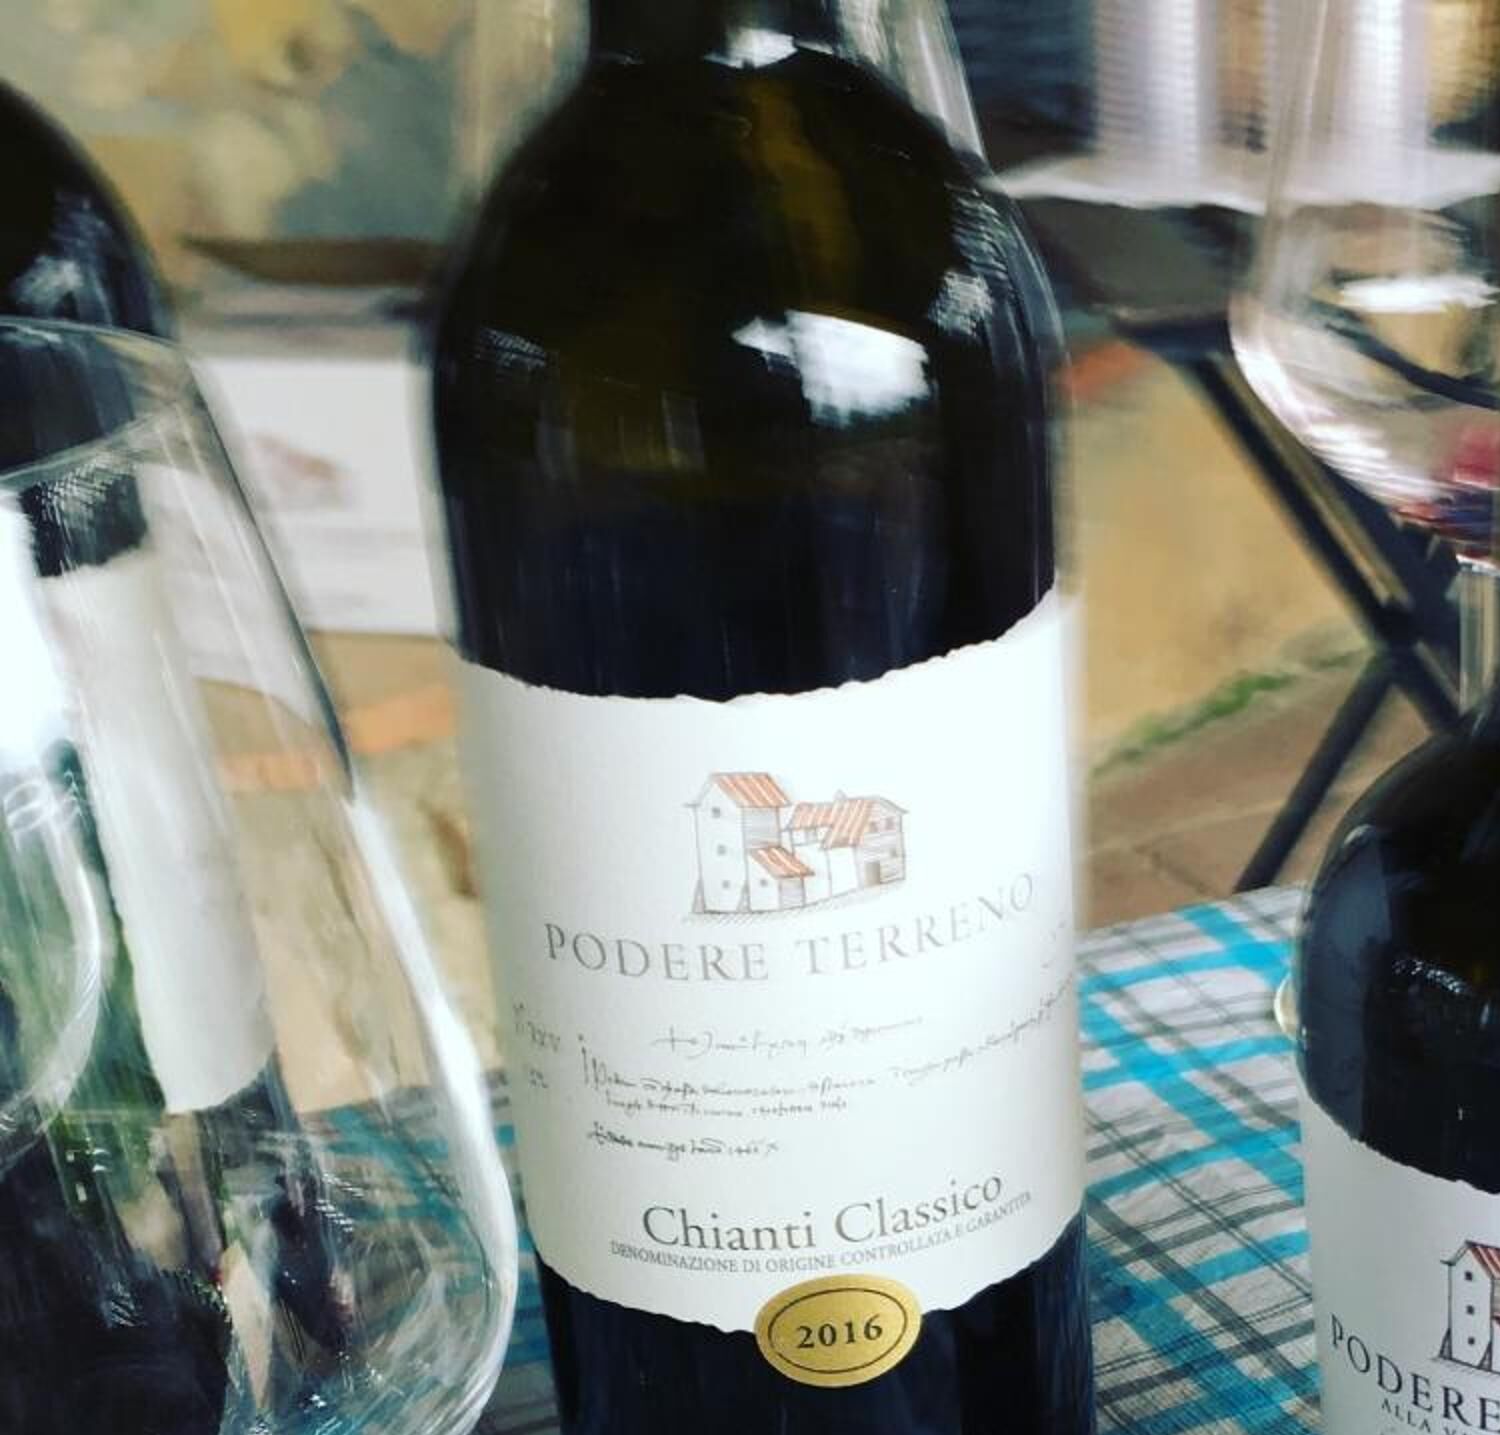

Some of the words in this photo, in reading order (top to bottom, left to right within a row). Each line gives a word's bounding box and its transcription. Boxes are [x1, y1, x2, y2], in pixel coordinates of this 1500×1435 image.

[544, 922, 770, 981] PODERE
[798, 872, 1035, 976] TERRENO
[642, 1206, 819, 1252] Chianti
[834, 1176, 1003, 1243] Classico
[609, 1240, 739, 1273] DENOMINAZIONE
[743, 1258, 761, 1274] DI
[765, 1253, 835, 1273] ORIGINE
[839, 1229, 951, 1266] CONTROLLATA
[795, 1314, 884, 1350] 2016
[1381, 1397, 1432, 1434] ALLA
